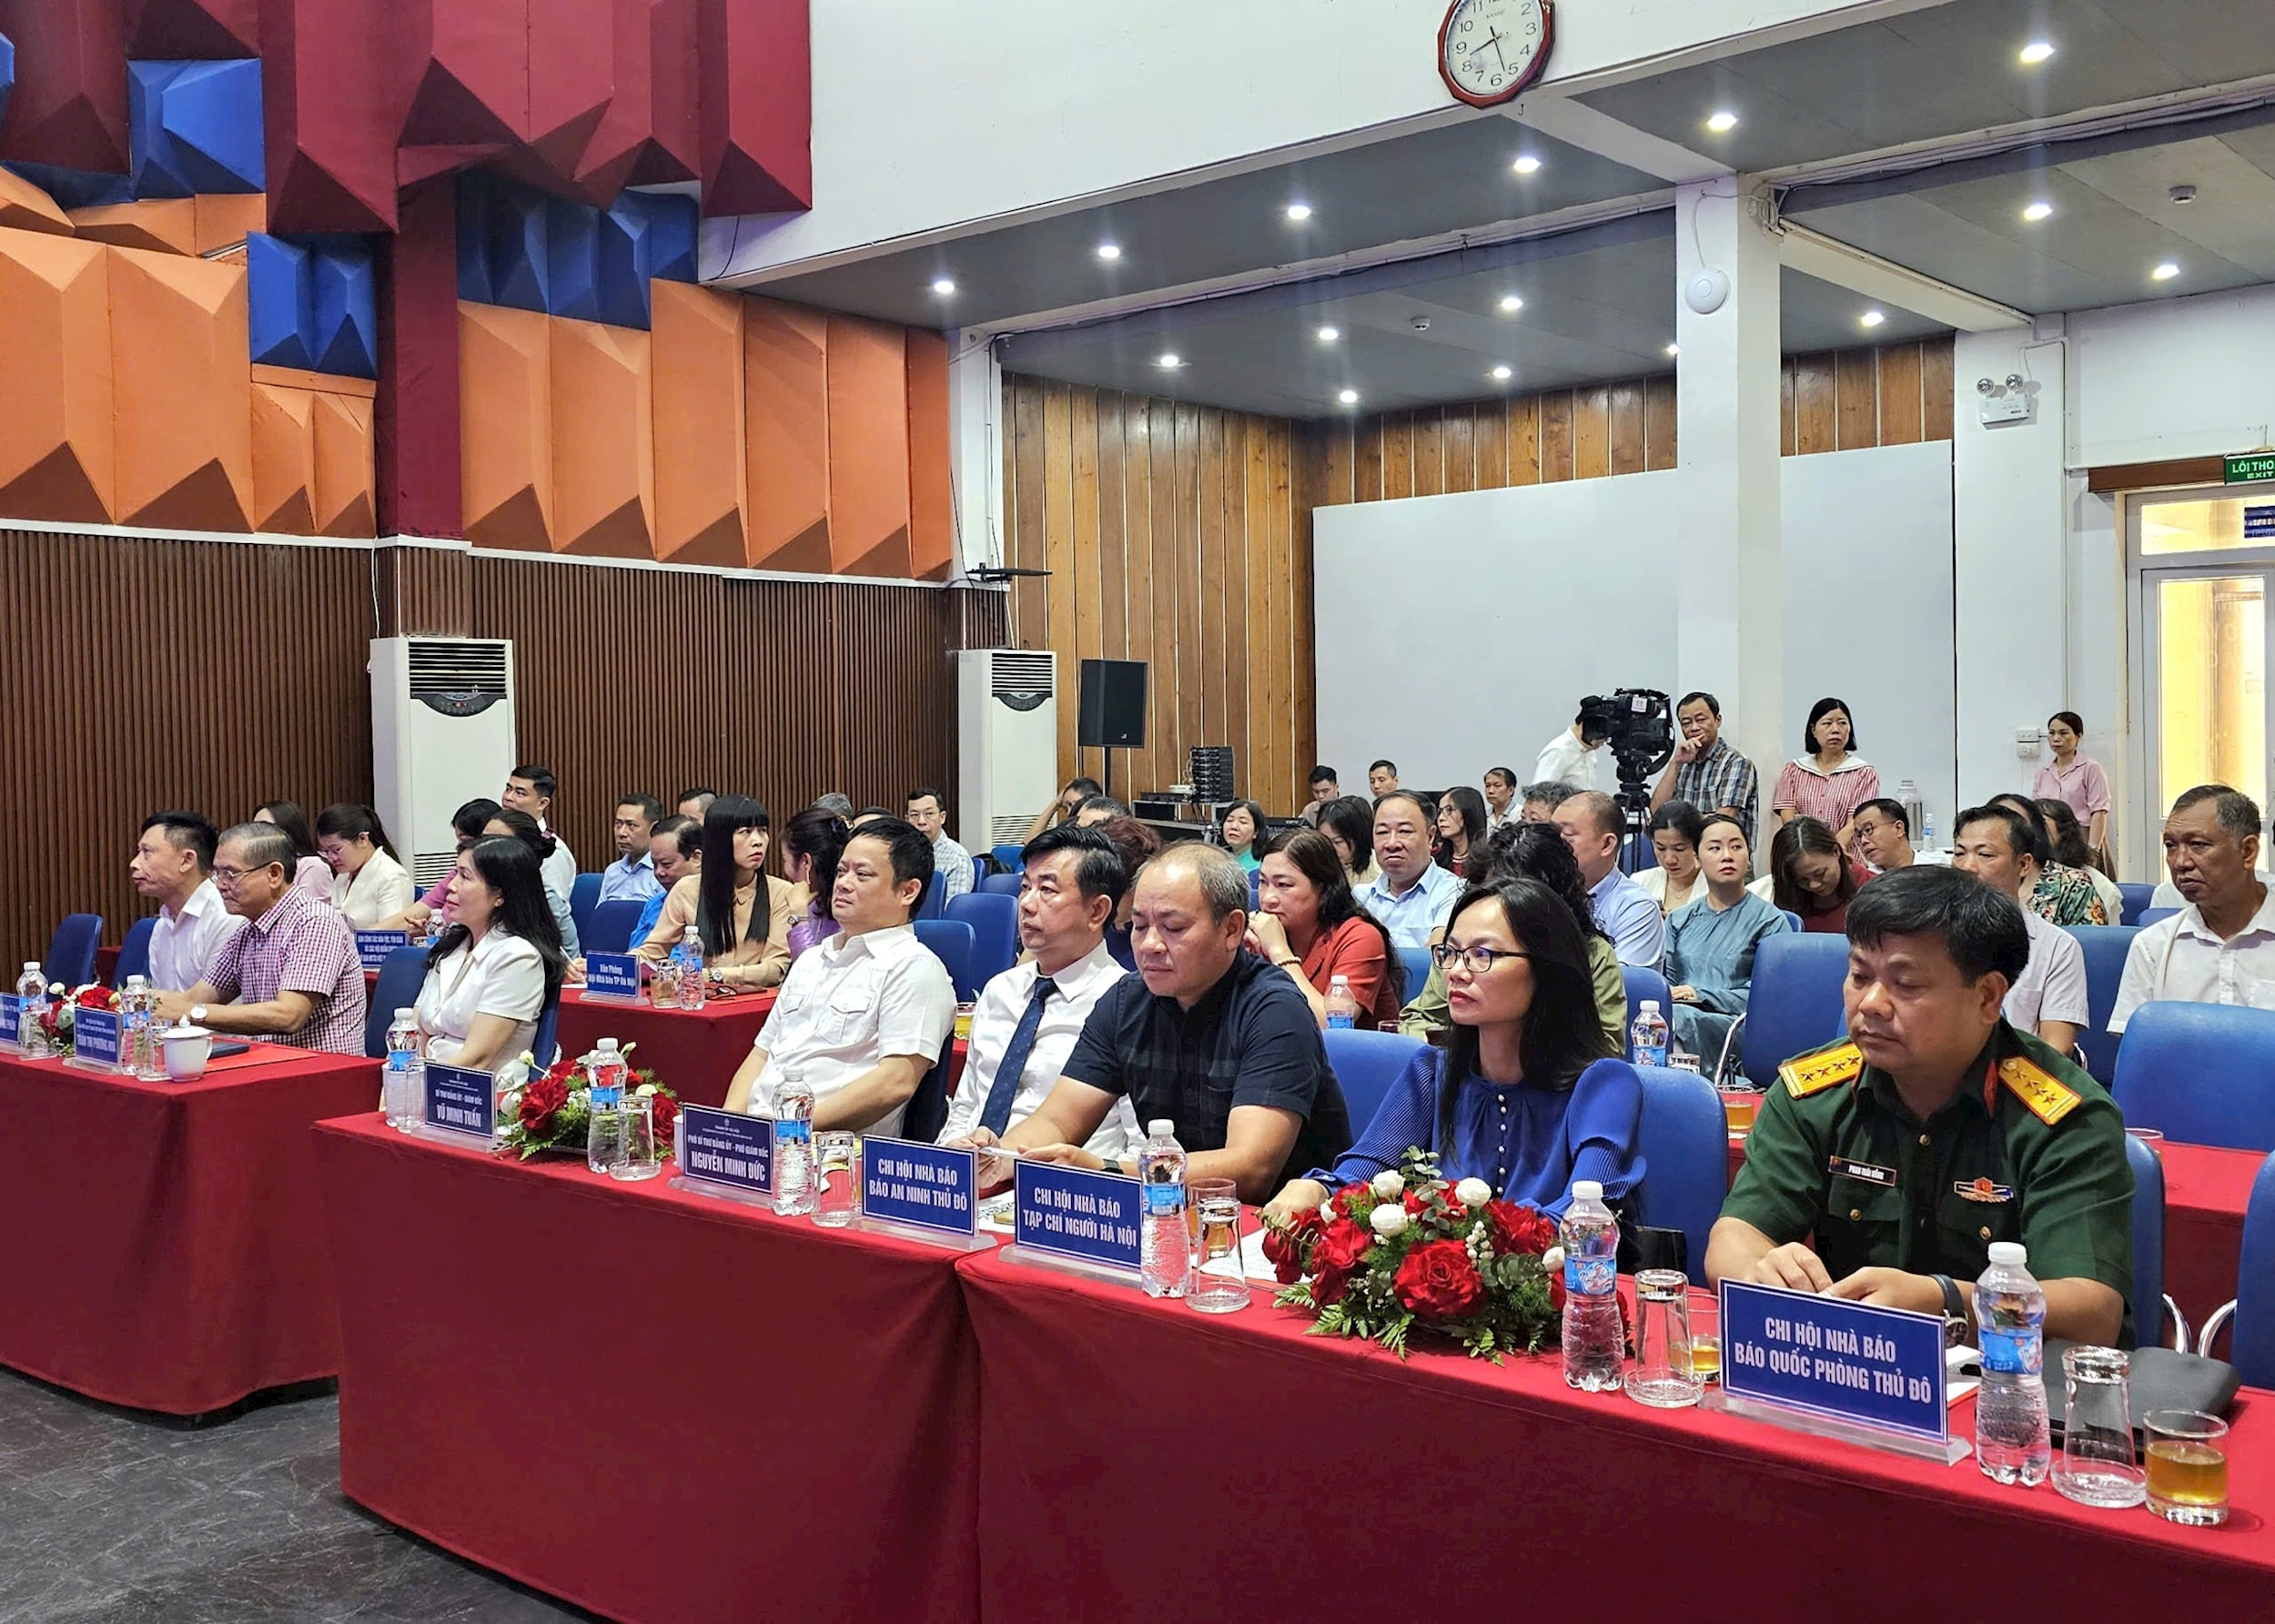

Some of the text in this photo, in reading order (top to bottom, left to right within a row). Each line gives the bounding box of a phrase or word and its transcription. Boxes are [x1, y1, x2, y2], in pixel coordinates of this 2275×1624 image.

[1472, 1, 1482, 14] 11
[1521, 2, 1532, 15] 2
[1460, 20, 1473, 33] 10
[1525, 22, 1536, 35] 3
[1456, 41, 1467, 55] 9
[1519, 44, 1531, 55] 4
[1461, 60, 1473, 73] 8
[1508, 62, 1519, 76] 5
[1474, 70, 1484, 83] 7
[1490, 73, 1502, 86] 6
[2251, 459, 2275, 472] THO
[2247, 470, 2274, 479] EXIT
[437, 1103, 446, 1120] VŨ
[463, 1106, 481, 1128] TUẤN
[687, 1134, 697, 1145] PHÓ
[735, 1144, 745, 1154] PHÓ
[745, 1145, 758, 1156] GIÁM
[758, 1146, 769, 1158] ĐỐC
[692, 1149, 766, 1182] NGUYỄN MINH ĐỨC
[878, 1158, 957, 1186] CHI HỘI NHÀ BÁO
[869, 1177, 889, 1198] BÁO
[891, 1183, 905, 1201] AN
[906, 1185, 931, 1205] NINH
[932, 1187, 951, 1209] THỦ
[953, 1192, 967, 1211] ĐÔ
[1034, 1186, 1121, 1219] CHI HỘI NHÀ BÁO
[1023, 1209, 1043, 1231] TẠP
[1045, 1212, 1063, 1233] CHÍ
[1065, 1216, 1097, 1240] NGƯỜI
[1099, 1222, 1115, 1244] HÀ
[1117, 1225, 1137, 1250] NỘI
[1764, 1316, 1896, 1363] CHI HỘI NHÀ BÁO
[1734, 1340, 1932, 1405] BÁO QUỐC PHÒNG THỦ ĐÔ
